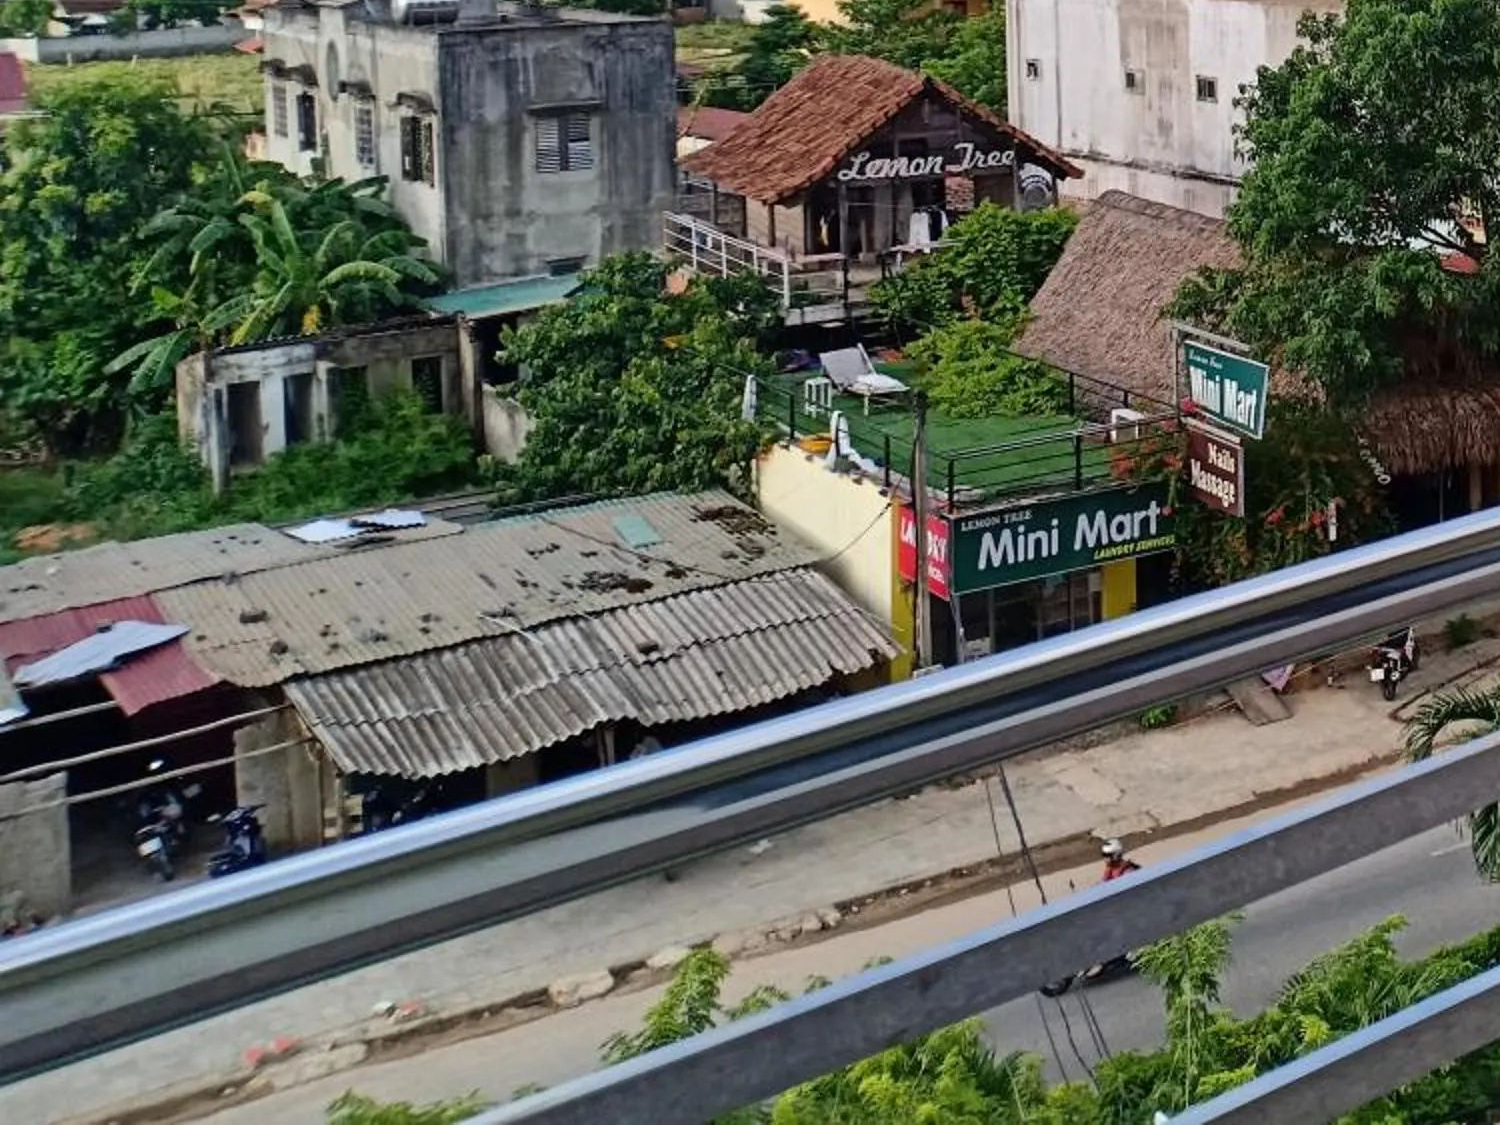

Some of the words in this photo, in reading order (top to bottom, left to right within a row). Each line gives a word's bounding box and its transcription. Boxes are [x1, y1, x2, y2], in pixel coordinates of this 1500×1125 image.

[838, 151, 944, 181] Lemon
[948, 142, 1014, 172] Tree
[1190, 365, 1221, 414] Mini
[1223, 378, 1257, 430] Mart
[1190, 458, 1236, 508] Massage
[1207, 442, 1235, 474] Nails
[977, 518, 1059, 571] Mini
[1074, 500, 1160, 551] Mart
